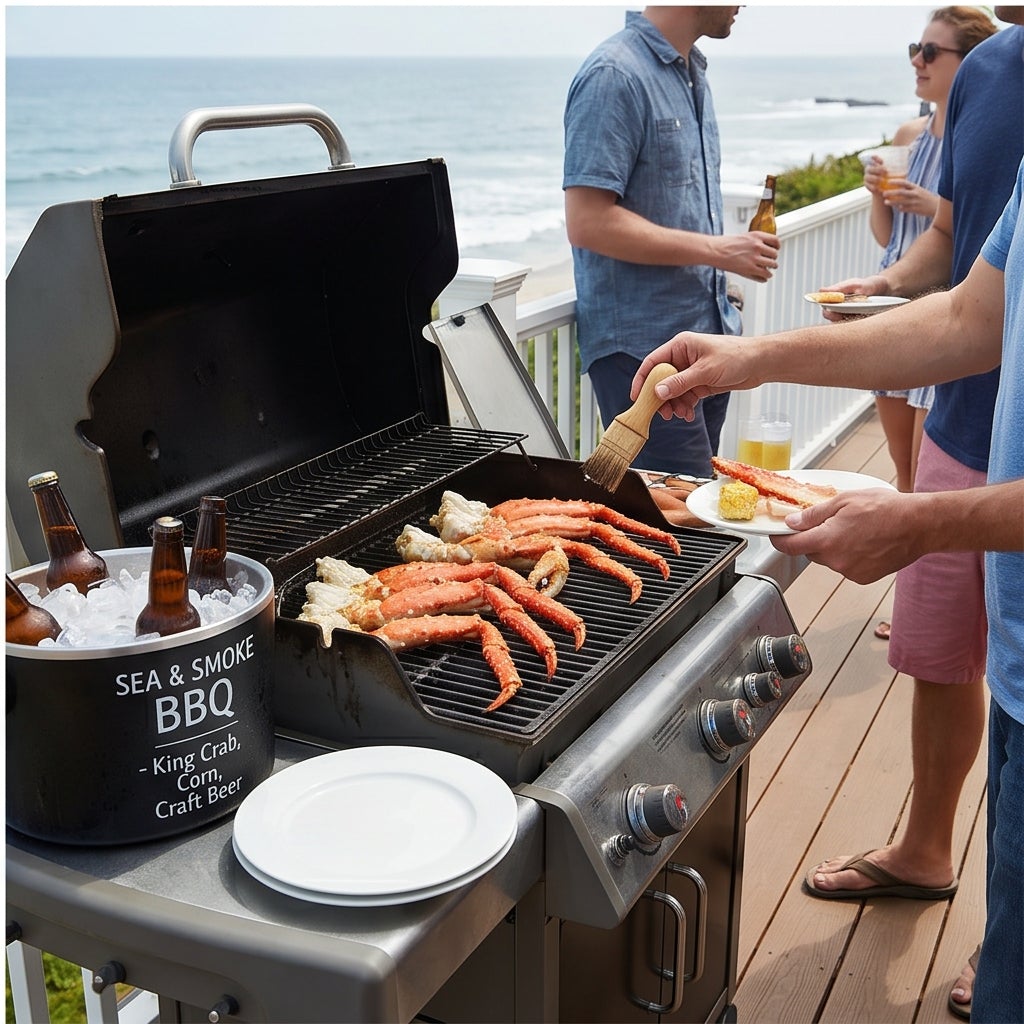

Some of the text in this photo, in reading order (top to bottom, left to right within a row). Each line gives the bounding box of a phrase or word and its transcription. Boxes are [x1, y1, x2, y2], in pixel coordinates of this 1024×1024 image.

[115, 634, 254, 696] SEA & SMOKE
[155, 677, 235, 734] BBQ
[153, 752, 196, 775] King
[200, 733, 241, 762] Crab,
[155, 776, 243, 819] Craft Beer
[177, 768, 223, 792] Corn,
